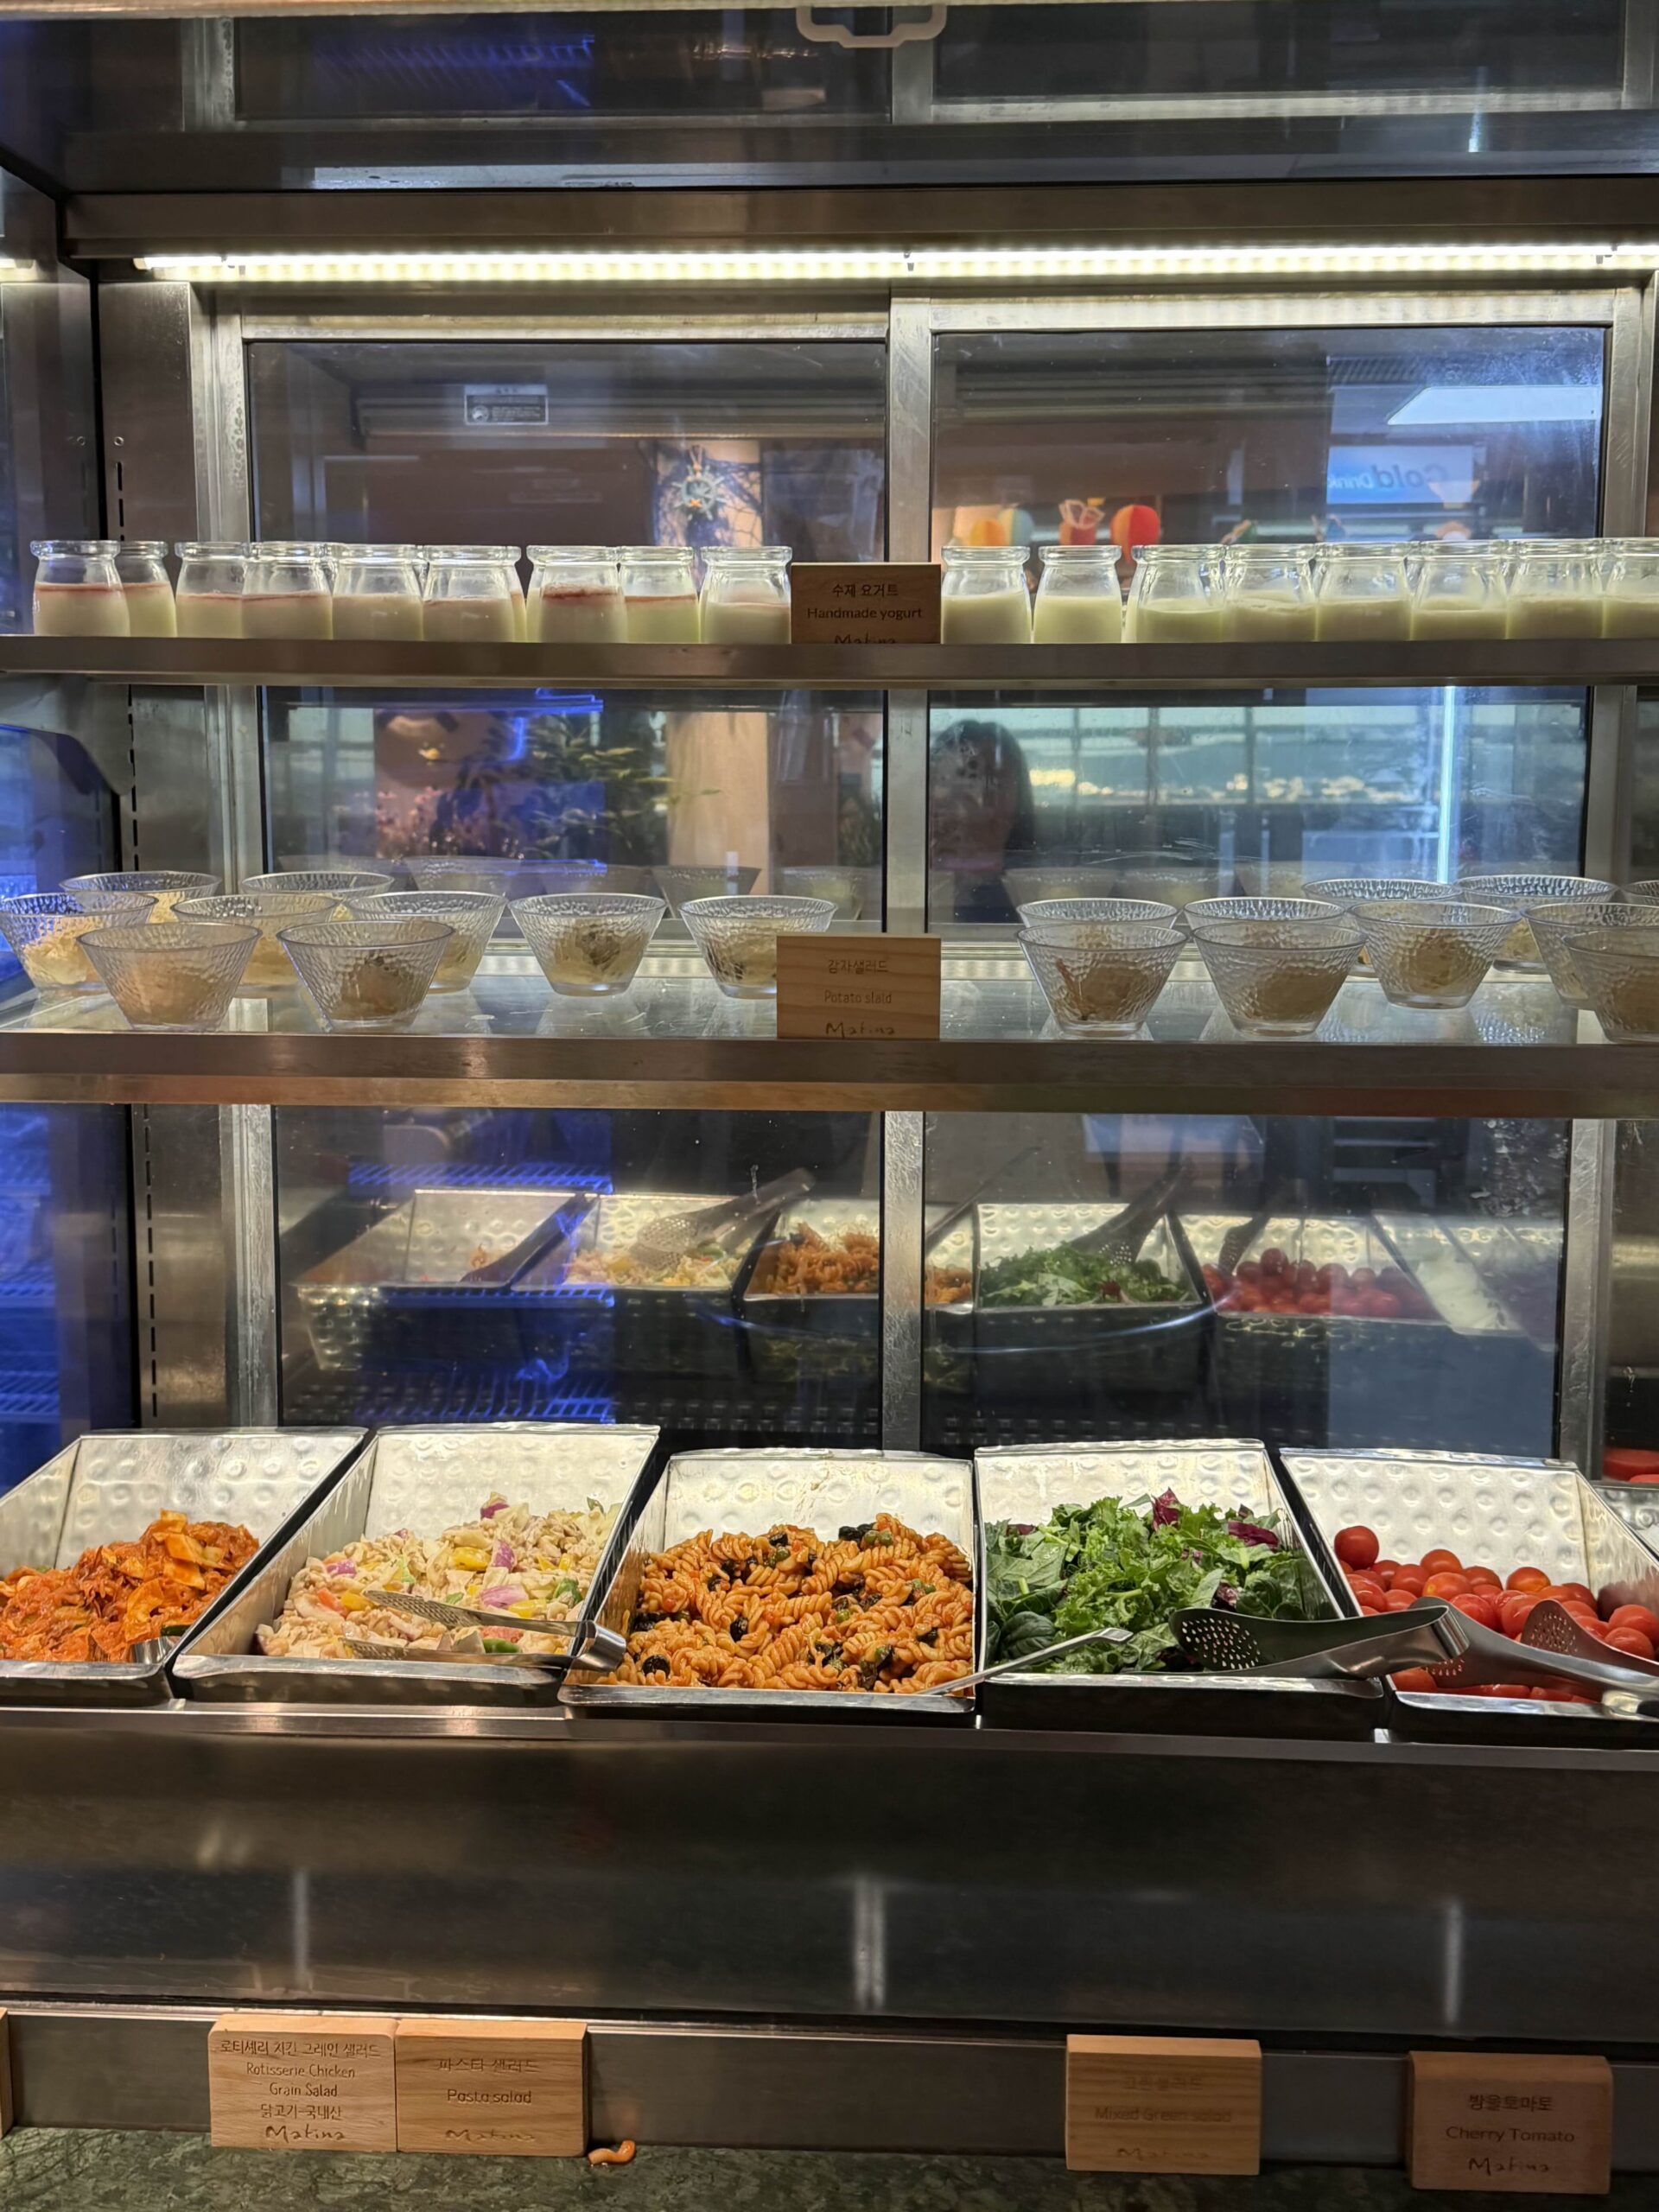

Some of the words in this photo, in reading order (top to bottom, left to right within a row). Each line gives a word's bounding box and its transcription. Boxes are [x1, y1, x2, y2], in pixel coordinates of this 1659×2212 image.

[832, 583, 856, 598] 수제
[861, 583, 899, 598] 요거트
[807, 607, 877, 620] Handmade
[880, 608, 922, 620] yogurt
[829, 959, 888, 975] 감자샐러드
[823, 990, 861, 1004] Potato
[274, 2041, 297, 2056] 치킨
[302, 2043, 339, 2058] 그레인
[246, 2062, 305, 2076] Rotisserie
[308, 2063, 355, 2078] Chicken
[437, 2057, 484, 2072] 파스타
[270, 2082, 302, 2095] Grain
[305, 2083, 338, 2097] Salad
[447, 2088, 489, 2103] Pasta
[493, 2090, 531, 2103] salad
[1469, 2094, 1553, 2112] 방울토마토
[1095, 2106, 1139, 2121] Mixed
[265, 2124, 346, 2143] Matina
[1446, 2126, 1505, 2142] Cherry
[1510, 2127, 1574, 2143] Tomato
